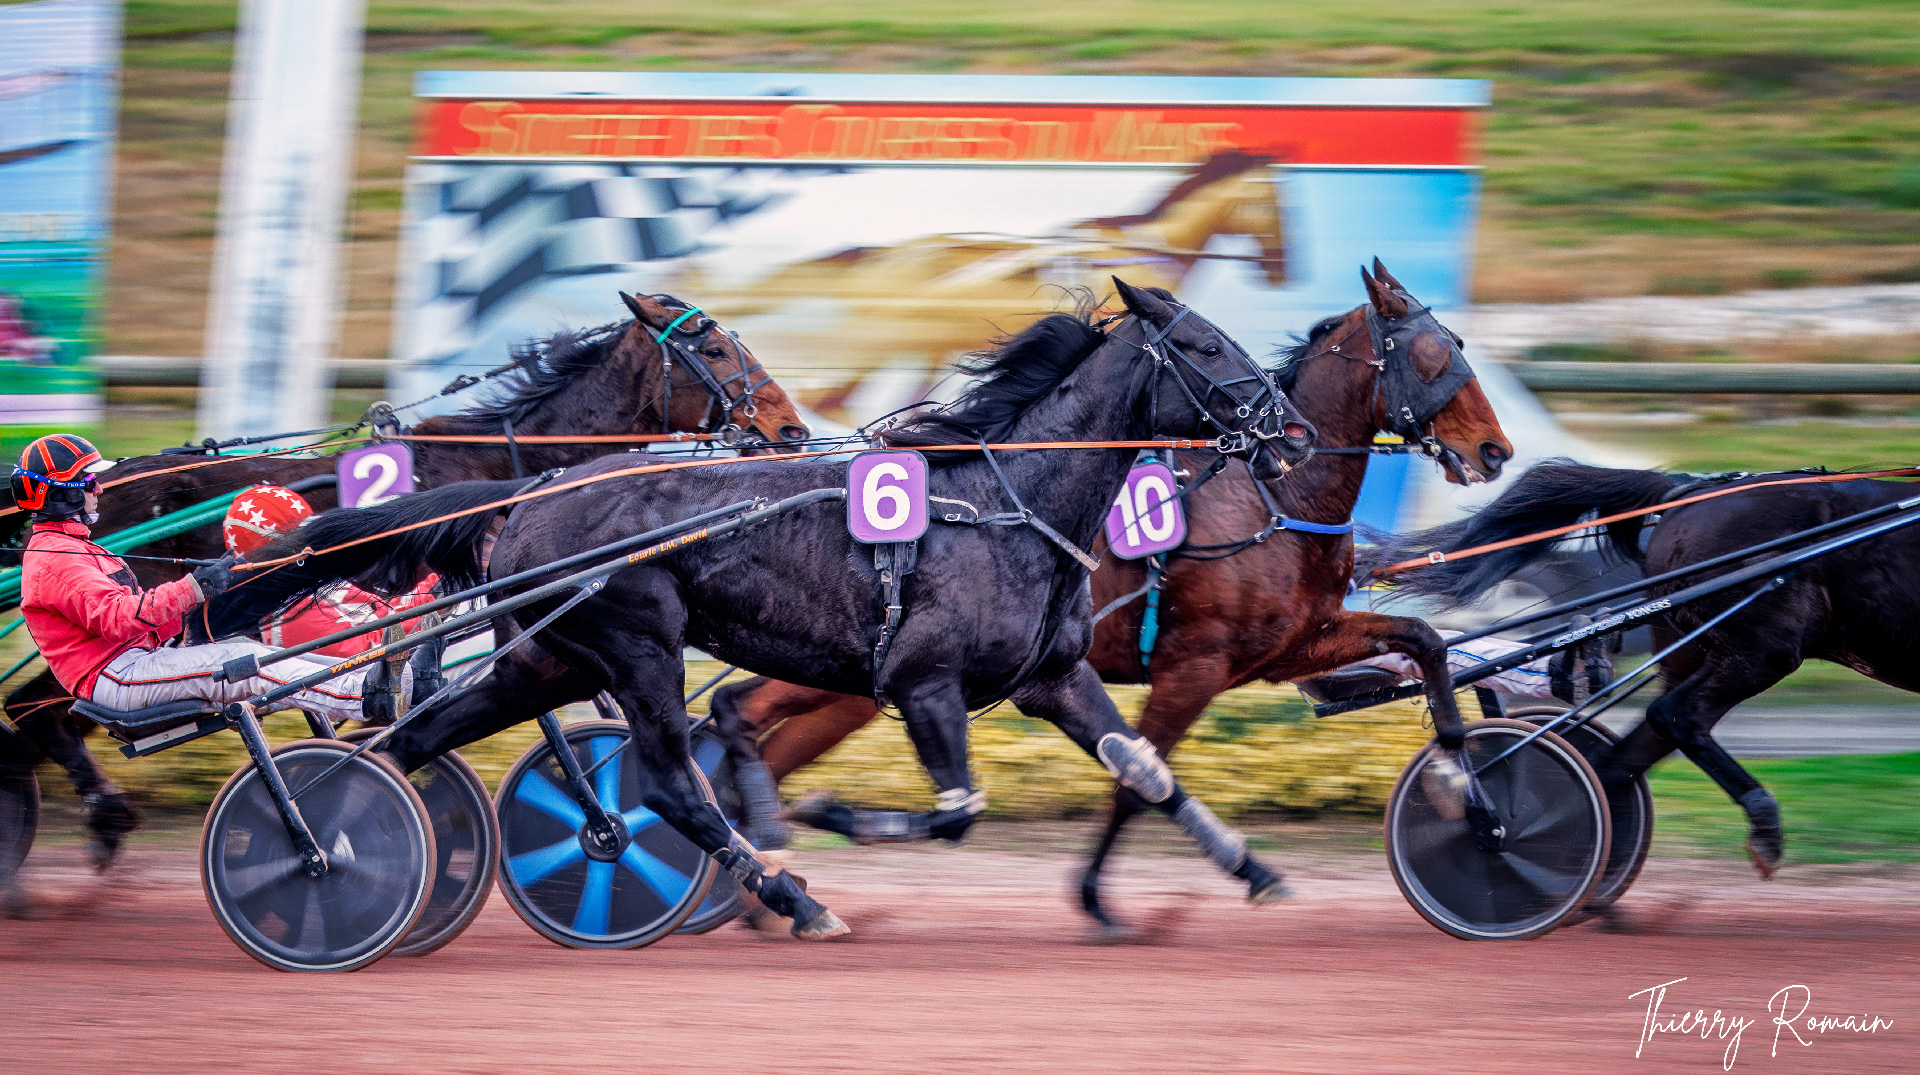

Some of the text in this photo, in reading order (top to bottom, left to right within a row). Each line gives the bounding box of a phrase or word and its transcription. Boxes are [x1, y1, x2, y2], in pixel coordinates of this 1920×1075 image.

[353, 452, 400, 509] 2
[862, 462, 911, 531] 6
[1113, 475, 1176, 547] 10
[628, 547, 657, 563] Ecurie
[681, 528, 708, 545] David
[330, 646, 388, 674] YANKEE
